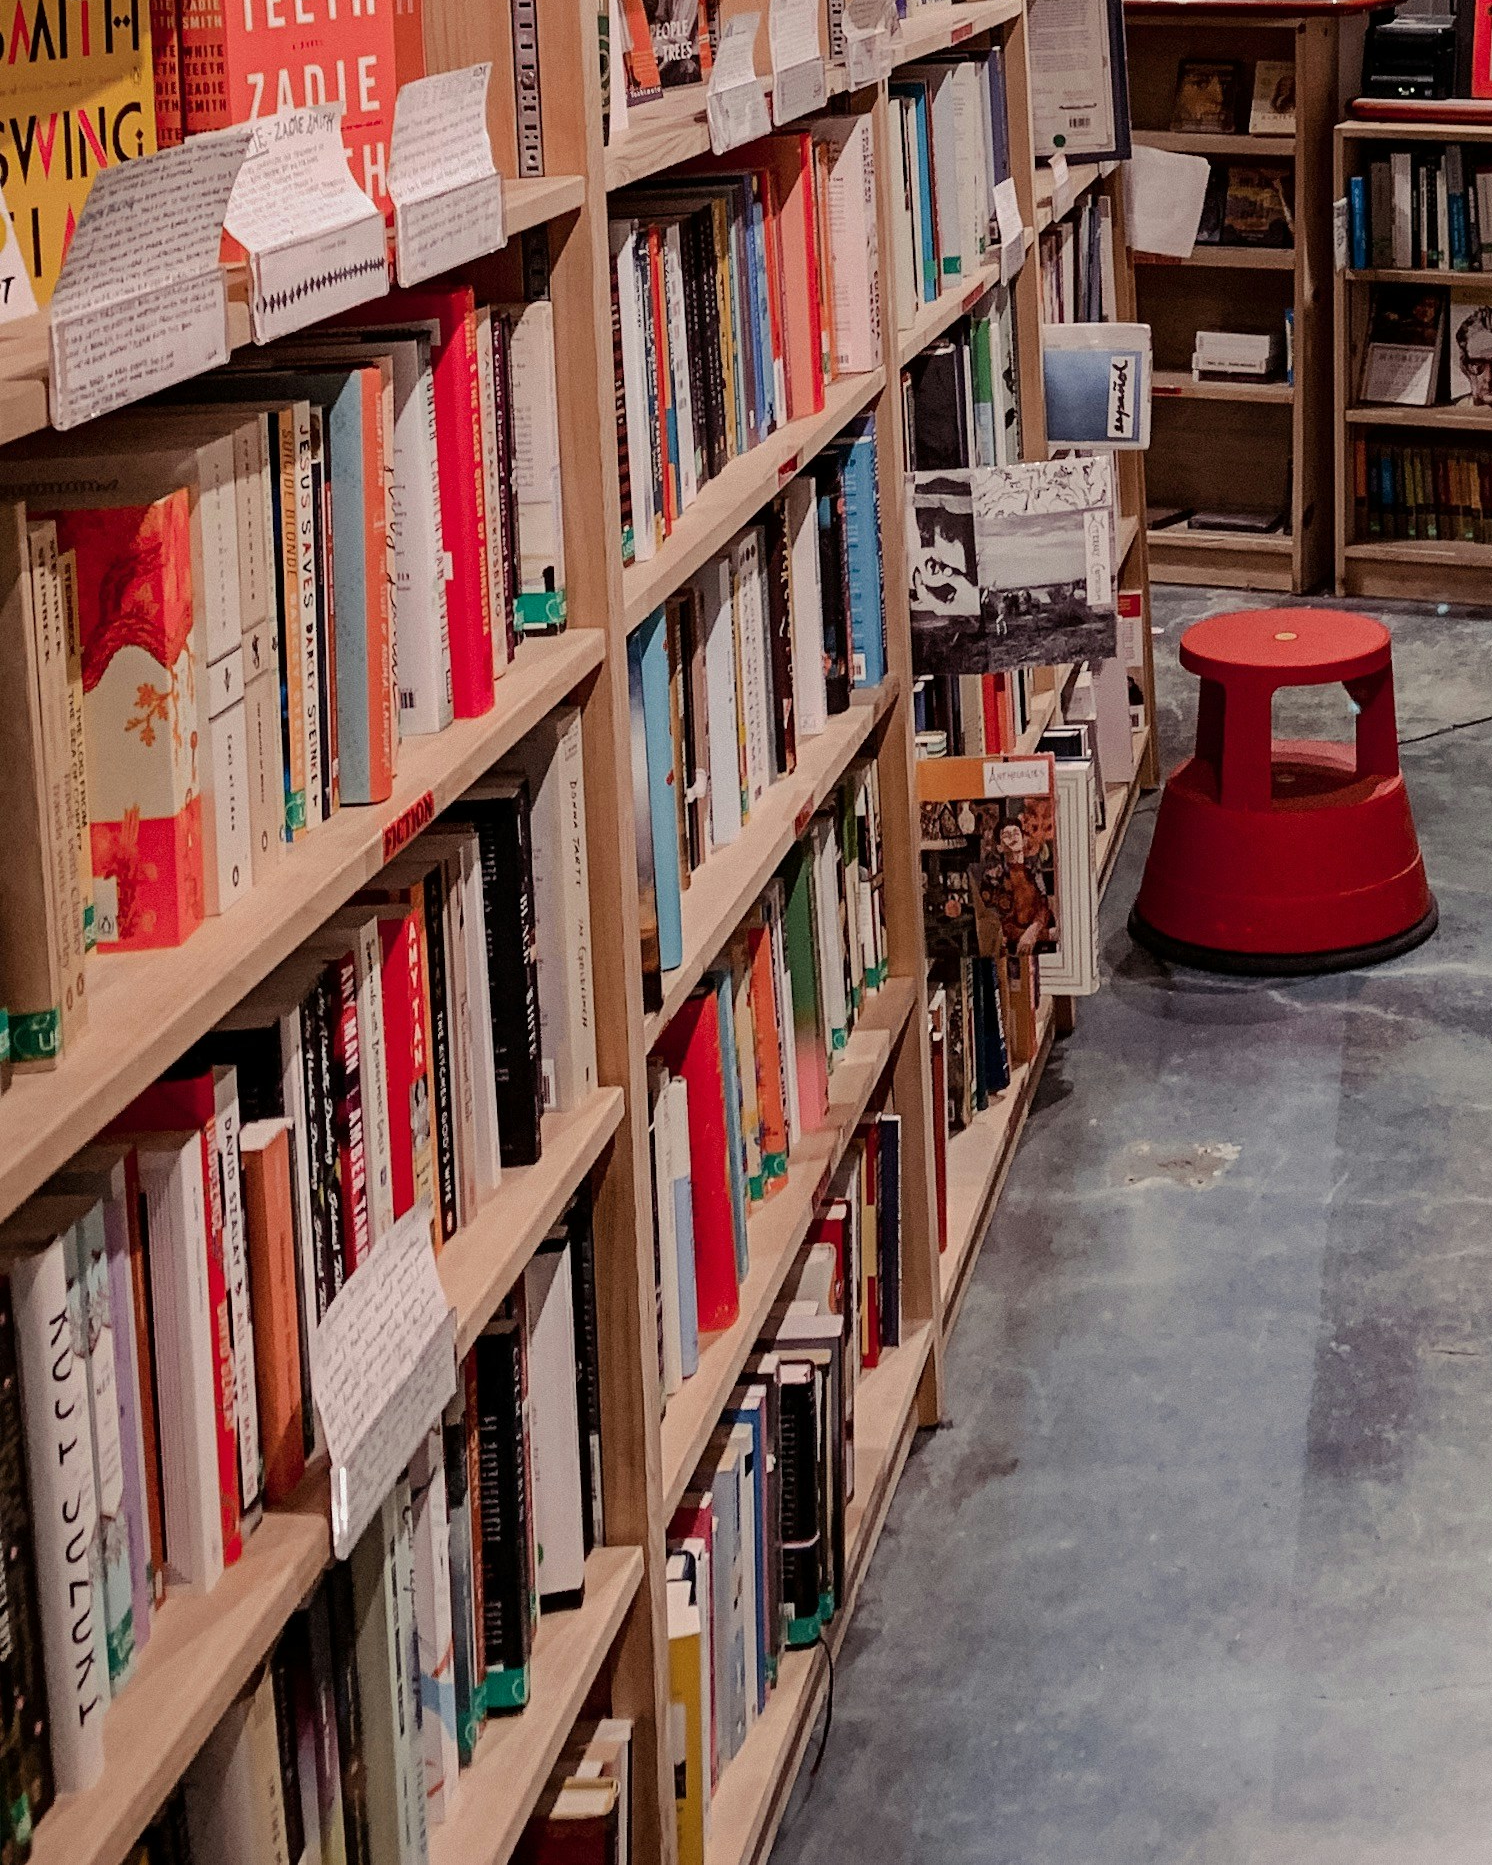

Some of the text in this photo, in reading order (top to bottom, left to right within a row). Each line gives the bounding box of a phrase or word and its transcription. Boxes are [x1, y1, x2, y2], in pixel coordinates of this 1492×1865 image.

[182, 16, 222, 30] SMITH
[663, 41, 693, 62] TREES
[246, 55, 380, 121] ZADIE
[1113, 357, 1130, 435] español
[281, 428, 297, 578] SUICIDE BLONDE
[37, 546, 51, 663] STEINBECK
[49, 538, 63, 656] STEINBECK
[299, 424, 320, 785] JESUS SAVES DARCEY STEINKE
[479, 547, 490, 635] MINNESOTA
[383, 792, 433, 859] FICTION
[568, 781, 584, 888] DONNA TARTT
[407, 921, 426, 1073] AMY TAN
[436, 1011, 446, 1040] THE
[341, 965, 367, 1193] ANY MAN AMBER
[223, 1117, 242, 1267] DAVID SZALAY
[47, 1306, 100, 1727] KOJI SUZUKI
